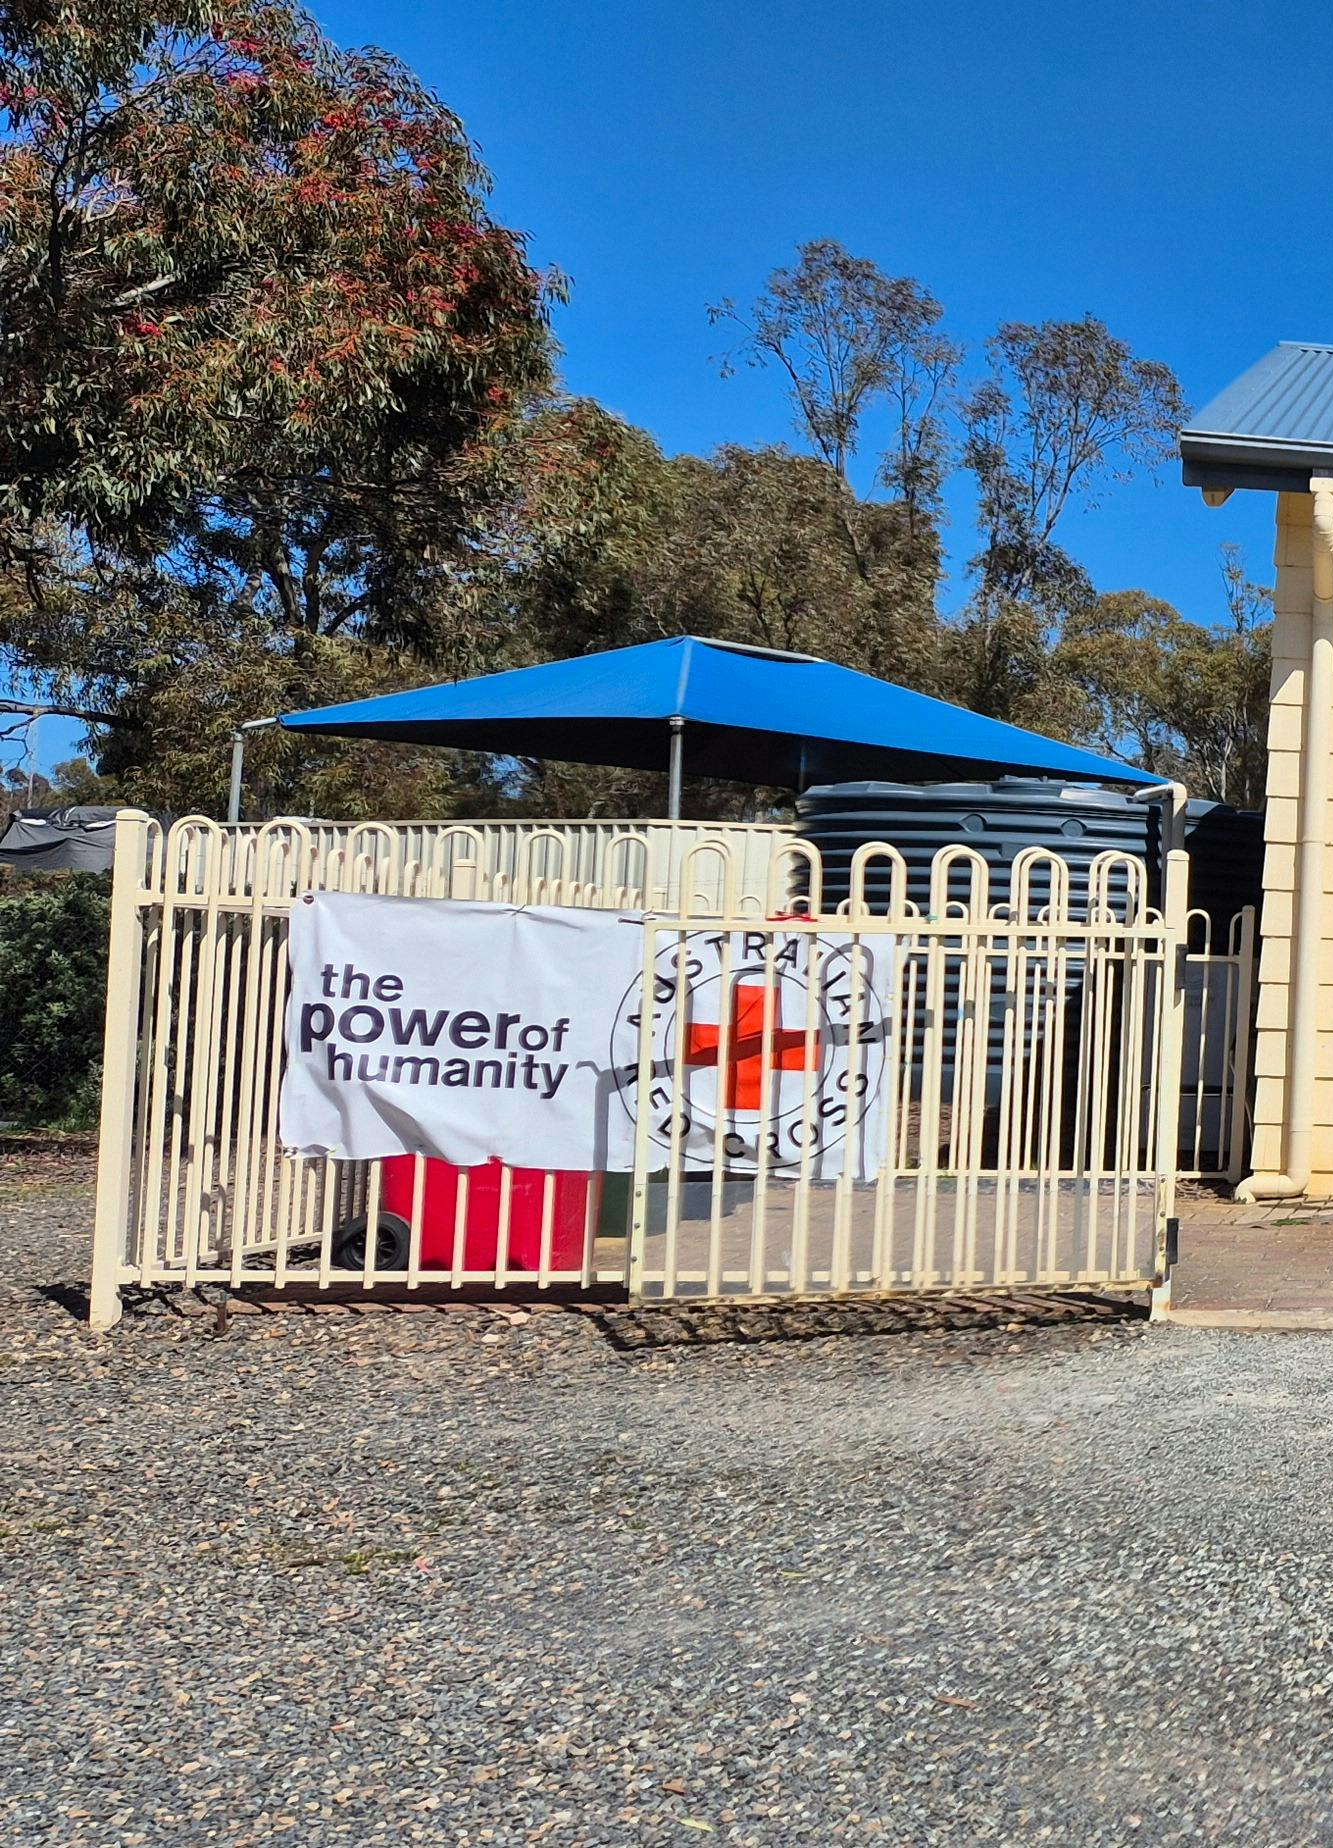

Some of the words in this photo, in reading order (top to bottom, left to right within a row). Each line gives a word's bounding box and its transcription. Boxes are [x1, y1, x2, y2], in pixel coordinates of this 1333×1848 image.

[320, 963, 404, 1002] the
[300, 1002, 521, 1053] power
[518, 1018, 570, 1051] of
[326, 1042, 569, 1100] humanity
[624, 1059, 691, 1140] RED
[722, 1069, 868, 1158] CROSS
